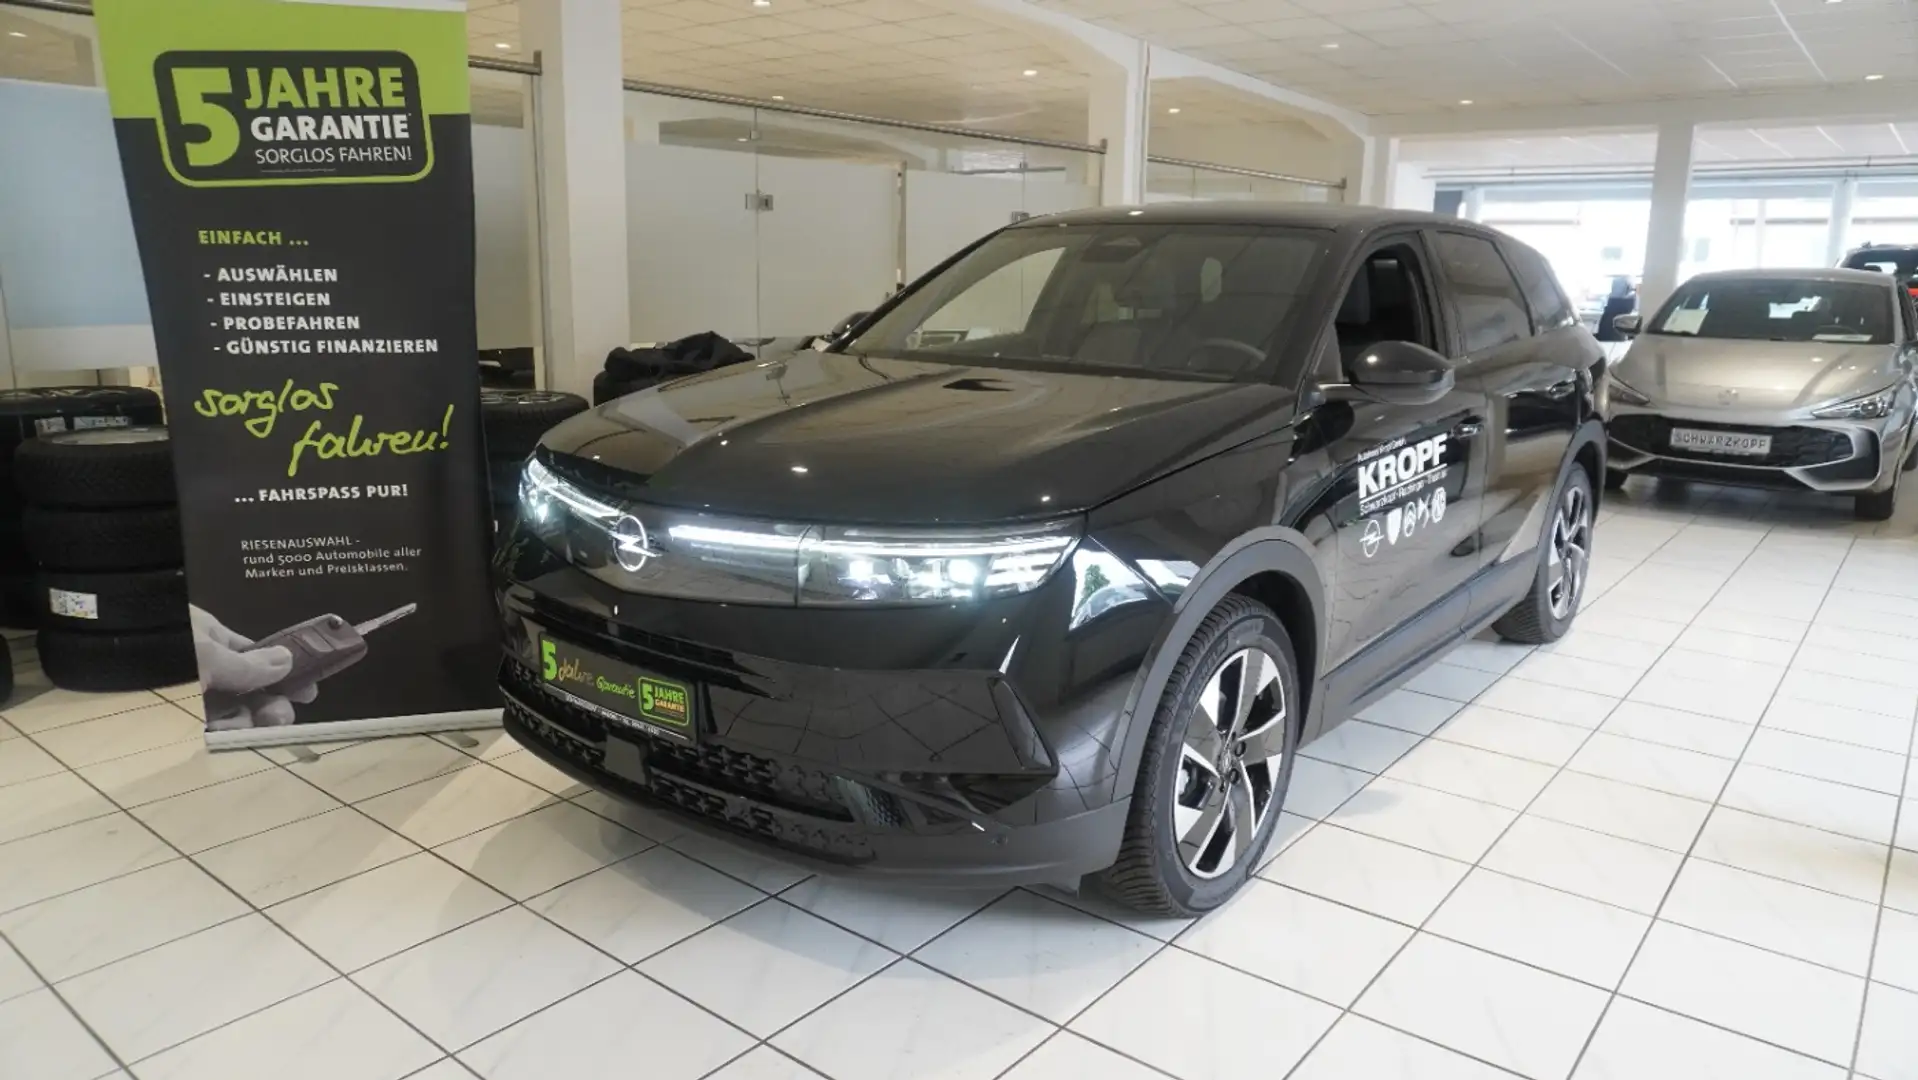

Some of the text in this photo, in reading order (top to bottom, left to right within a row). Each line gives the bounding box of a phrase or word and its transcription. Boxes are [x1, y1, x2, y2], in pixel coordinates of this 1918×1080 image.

[170, 67, 406, 167] 5 JAHRE
[255, 146, 412, 164] SORGLOS FAHREN!
[198, 230, 282, 245] EINFACH
[217, 264, 338, 282] AUSWÄHLEN
[219, 291, 331, 306] EINSTEIGEN
[223, 315, 360, 331] PROBEFAHREN
[226, 337, 311, 354] GÜNSTIG
[316, 338, 438, 354] FINANZIEREN
[194, 378, 340, 439] sorglos
[287, 403, 455, 477] fahren!
[1674, 433, 1766, 450] SCHWARZKOPF
[1358, 433, 1448, 499] KROPF
[258, 486, 361, 502] FAHRSPASS
[366, 483, 409, 498] PUR!
[240, 535, 352, 551] RIESENAUSWAHL
[243, 546, 422, 567] rund 5000 Automobile aller
[245, 561, 409, 579] Marken und Preisklassen.
[541, 639, 558, 681] 5
[641, 682, 655, 711] 5
[654, 686, 685, 705] JAHRE
